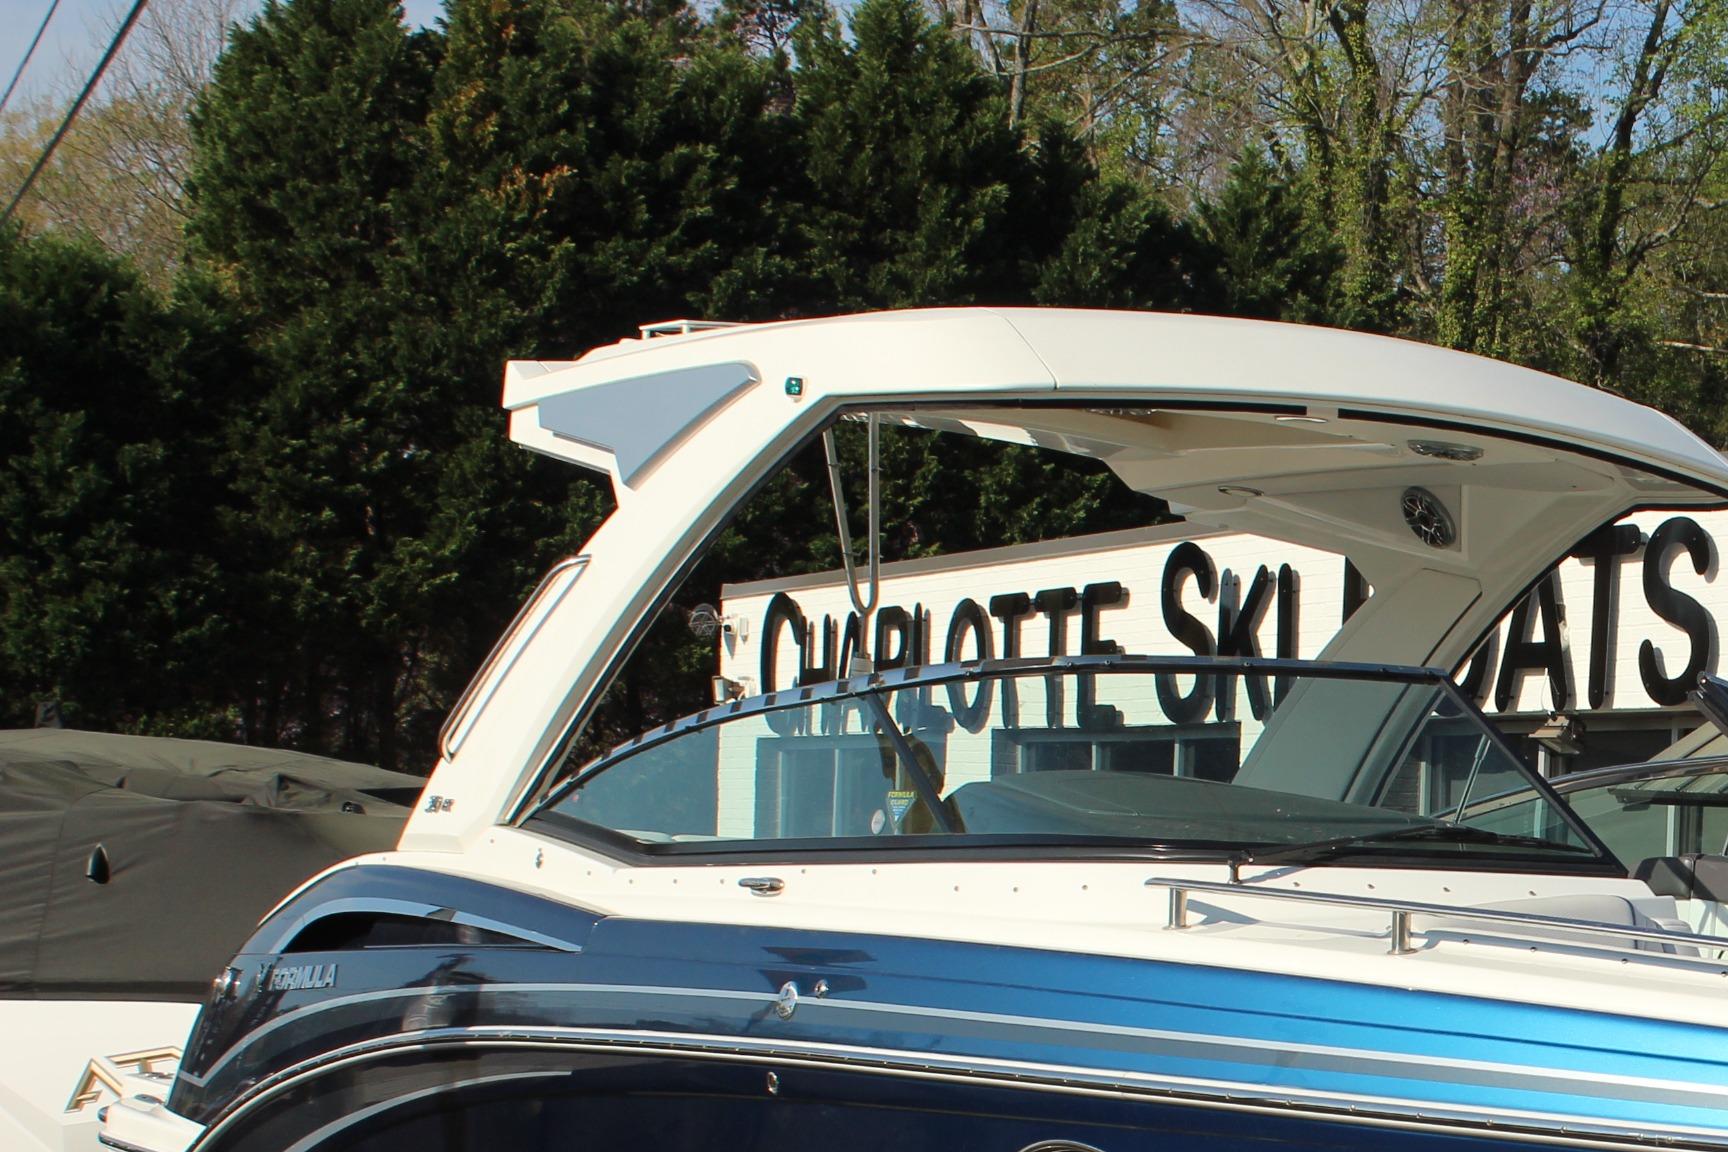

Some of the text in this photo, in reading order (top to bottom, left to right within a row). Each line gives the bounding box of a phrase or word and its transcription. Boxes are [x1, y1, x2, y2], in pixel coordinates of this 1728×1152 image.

[761, 581, 1123, 735] CHARLOTTE
[1156, 541, 1295, 724] SKI
[268, 963, 338, 991] FORMULA
